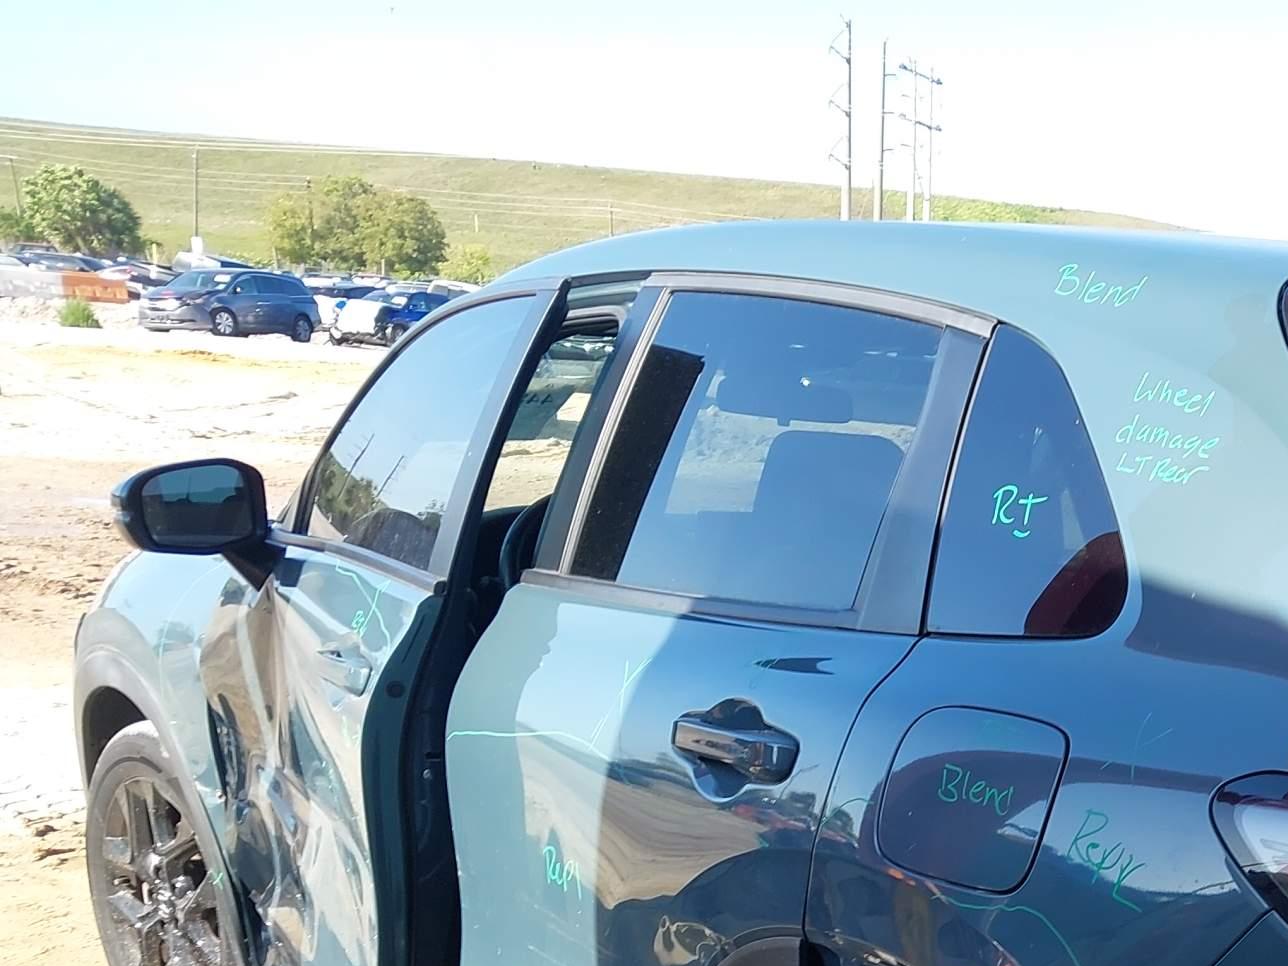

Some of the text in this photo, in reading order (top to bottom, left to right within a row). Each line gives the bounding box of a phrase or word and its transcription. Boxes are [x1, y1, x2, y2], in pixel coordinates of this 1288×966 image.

[1054, 263, 1148, 307] Blend
[1133, 371, 1216, 417] Wheel
[1115, 414, 1220, 459] damage
[1149, 457, 1210, 485] Rear
[937, 763, 1014, 816] Blend
